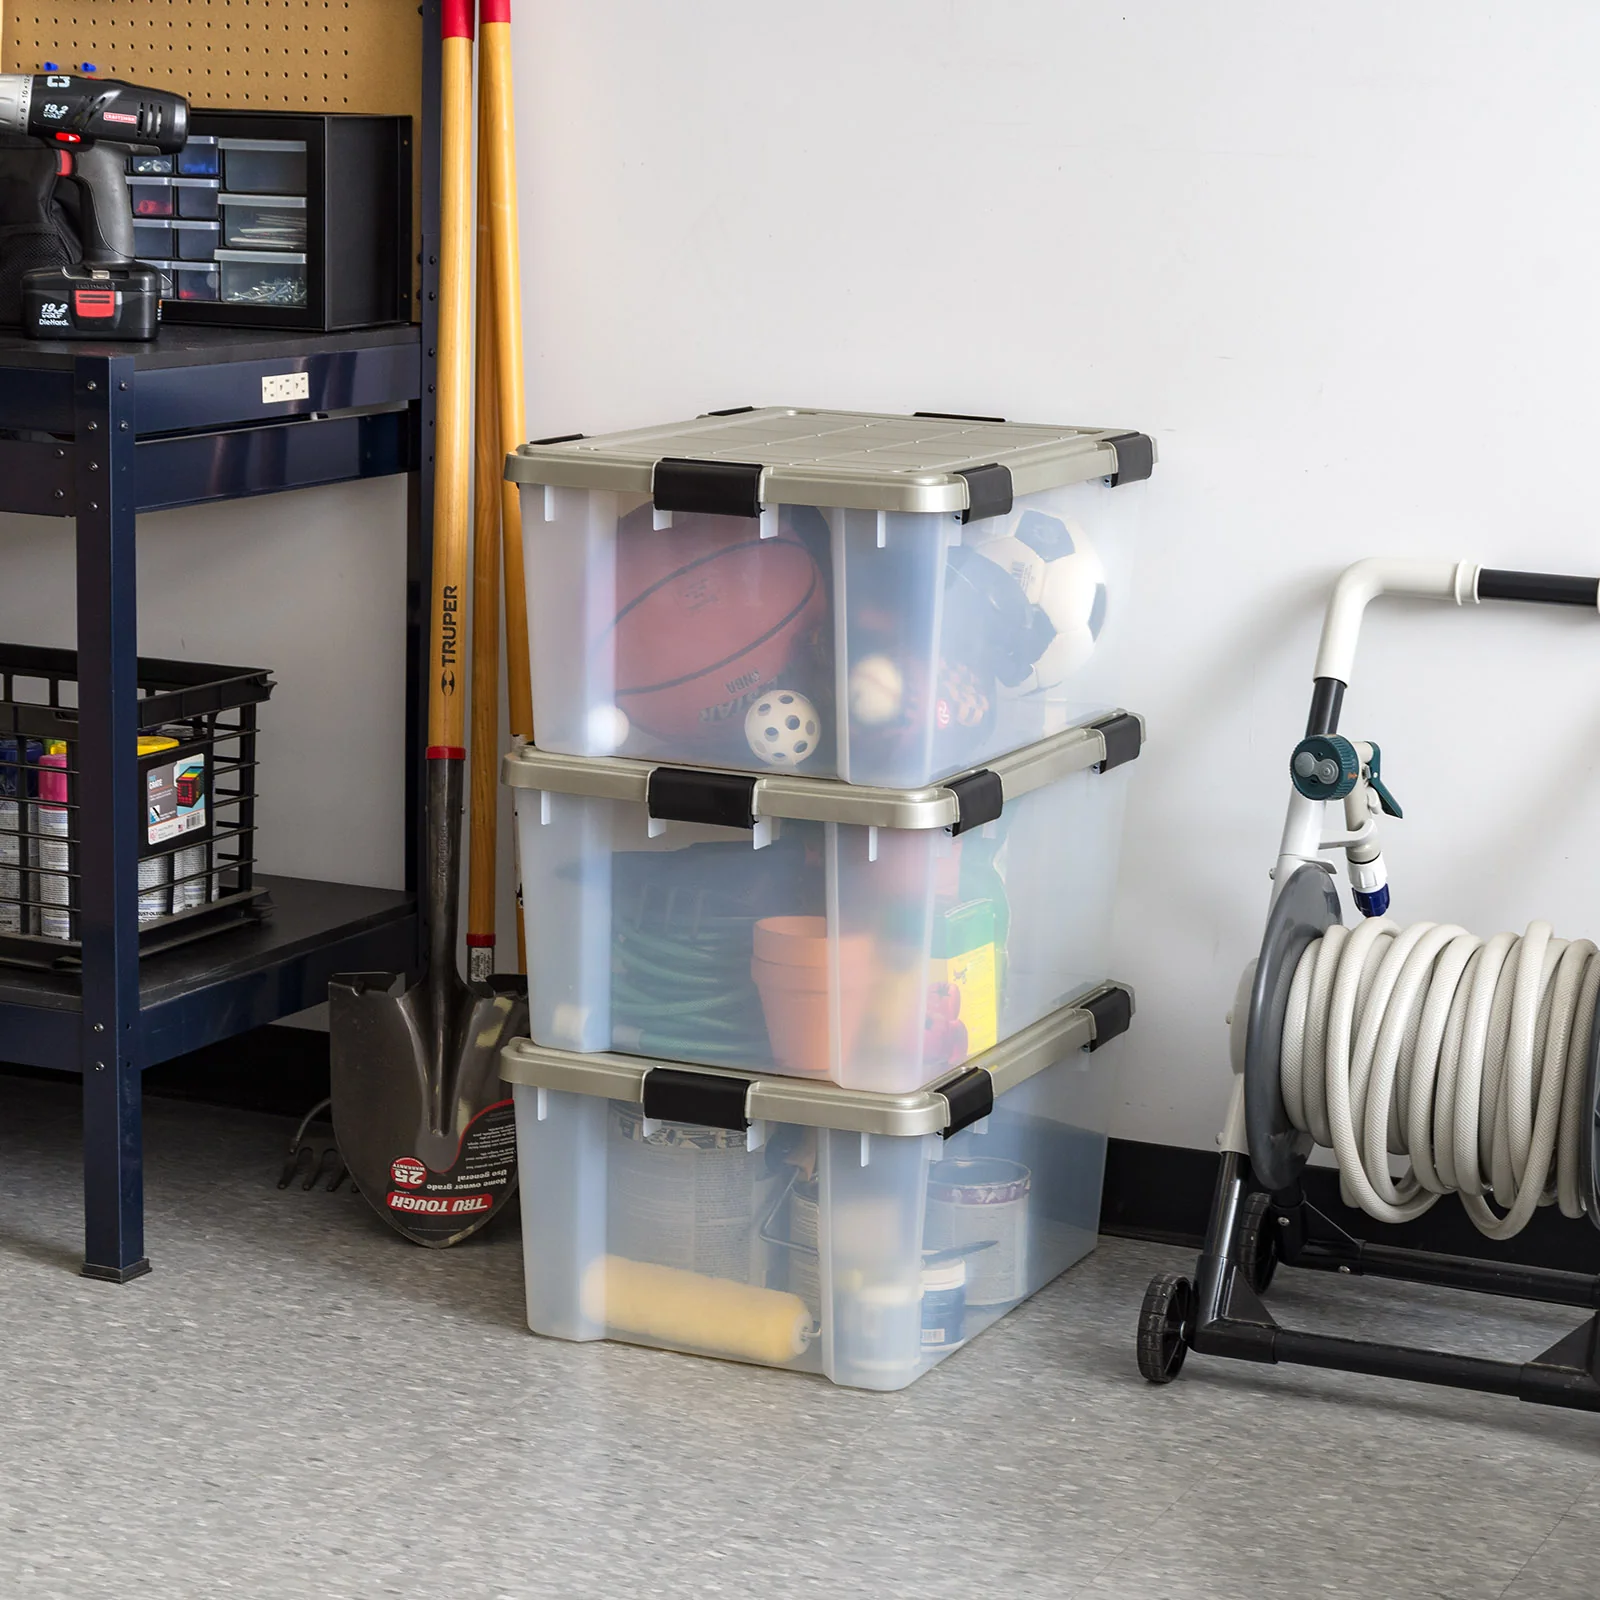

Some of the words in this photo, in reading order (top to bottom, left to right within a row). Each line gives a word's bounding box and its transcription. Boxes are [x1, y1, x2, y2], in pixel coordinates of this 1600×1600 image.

[47, 75, 71, 88] C3
[44, 103, 69, 115] 19.2
[41, 303, 68, 313] 19.2
[442, 585, 458, 668] TRUPER
[394, 1169, 424, 1185] 25
[457, 1170, 490, 1182] general
[492, 1168, 507, 1177] Use
[426, 1182, 453, 1191] grade
[454, 1182, 481, 1190] owner
[483, 1177, 507, 1187] Home
[391, 1195, 447, 1212] TOUGH
[452, 1198, 488, 1212] TRU
